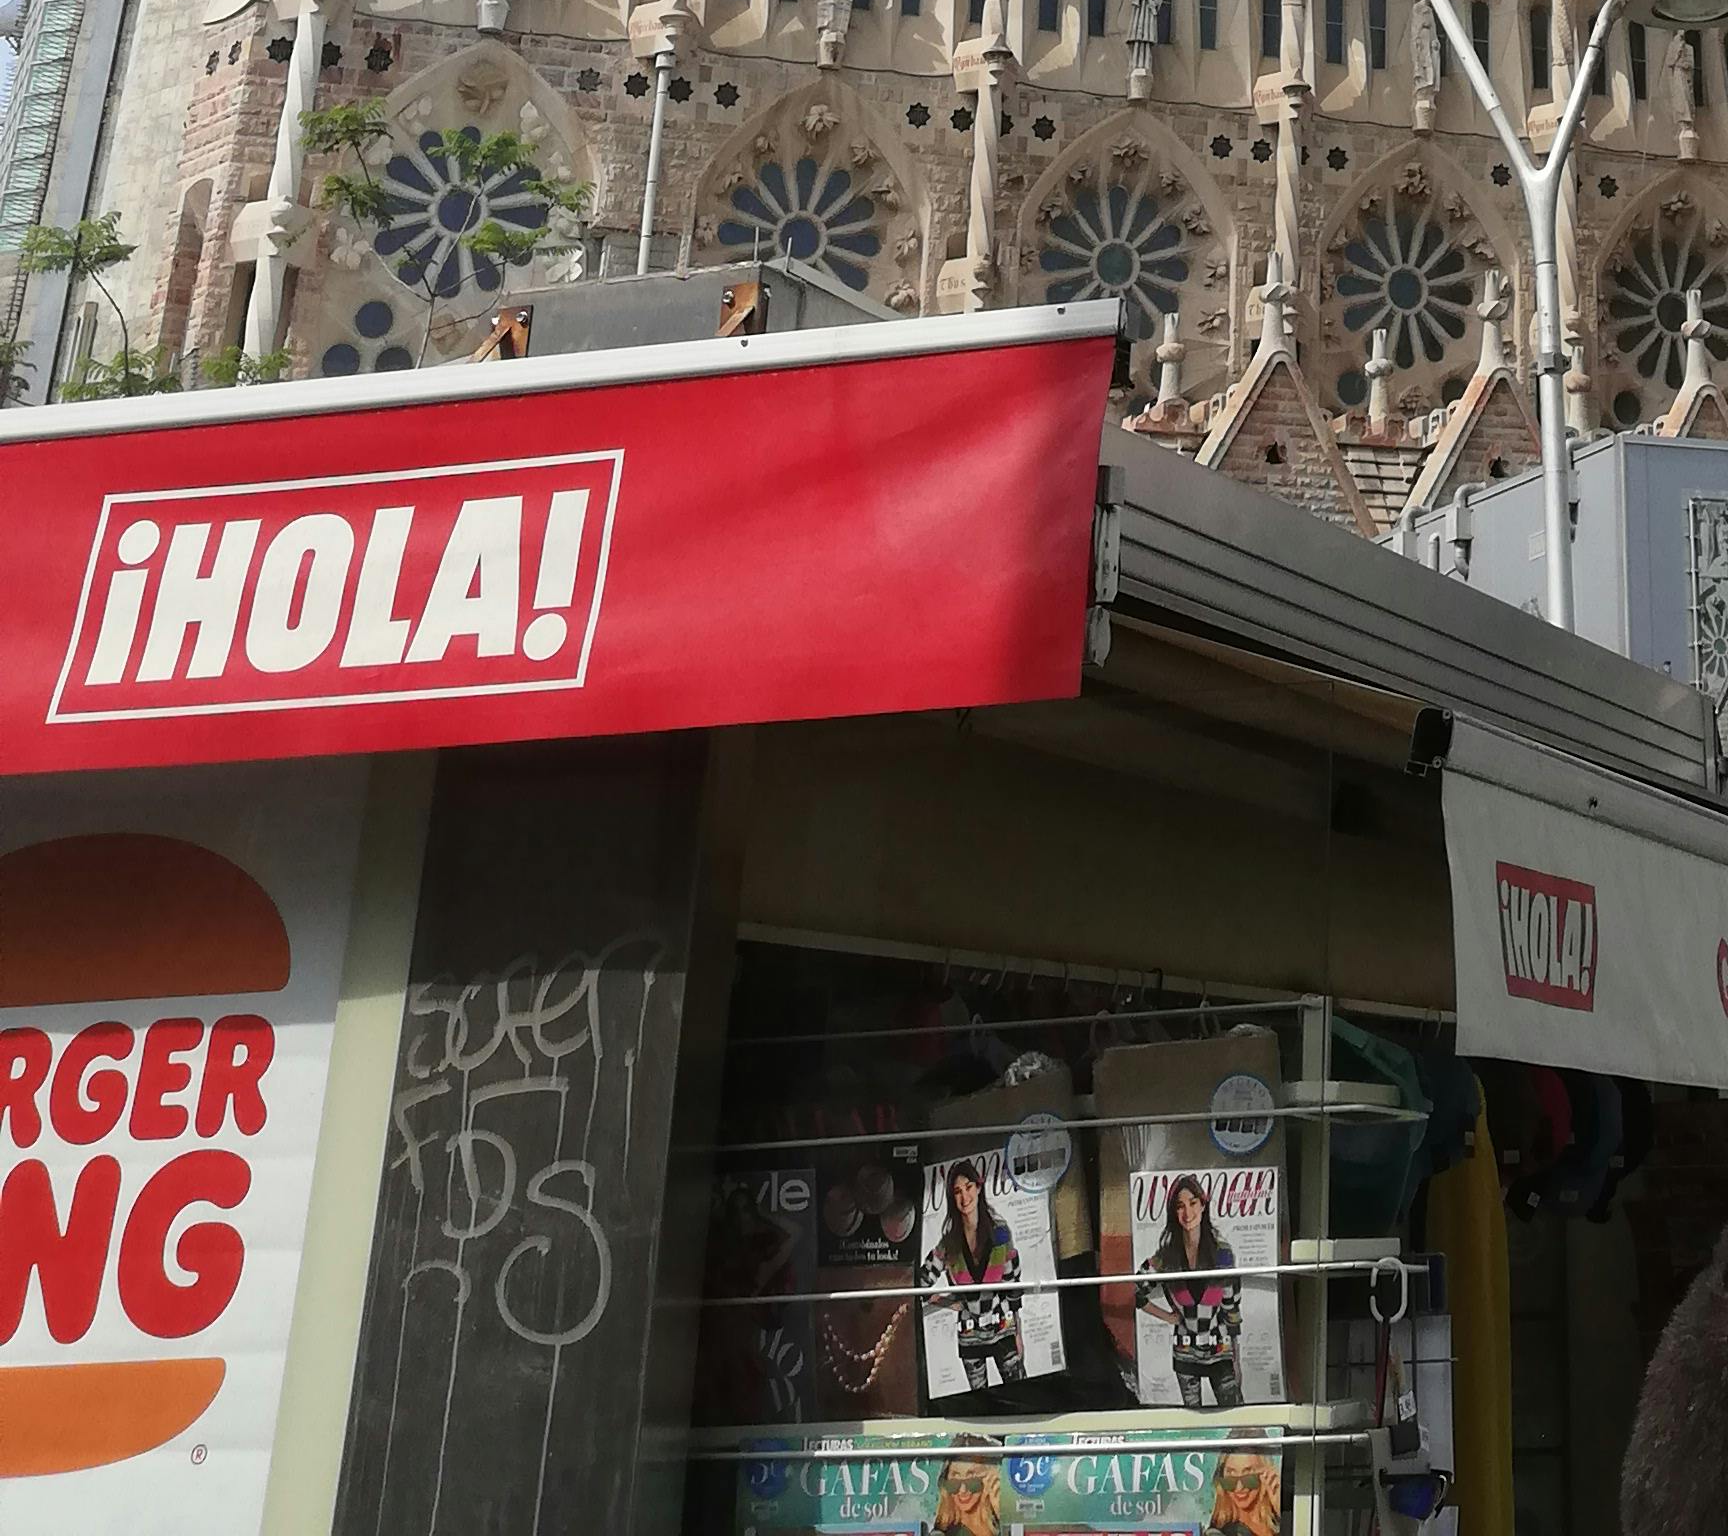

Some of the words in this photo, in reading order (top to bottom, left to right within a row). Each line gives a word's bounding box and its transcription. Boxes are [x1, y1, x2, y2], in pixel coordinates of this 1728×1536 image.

[84, 488, 591, 686] ¡HOLA!
[1500, 879, 1594, 996] ¡HOLA!
[800, 1457, 931, 1499] GAFAS
[1067, 1452, 1205, 1496] GAFAS
[839, 1497, 862, 1519] de
[864, 1496, 890, 1518] sol
[1110, 1494, 1133, 1517] de
[1136, 1493, 1163, 1516] sol
